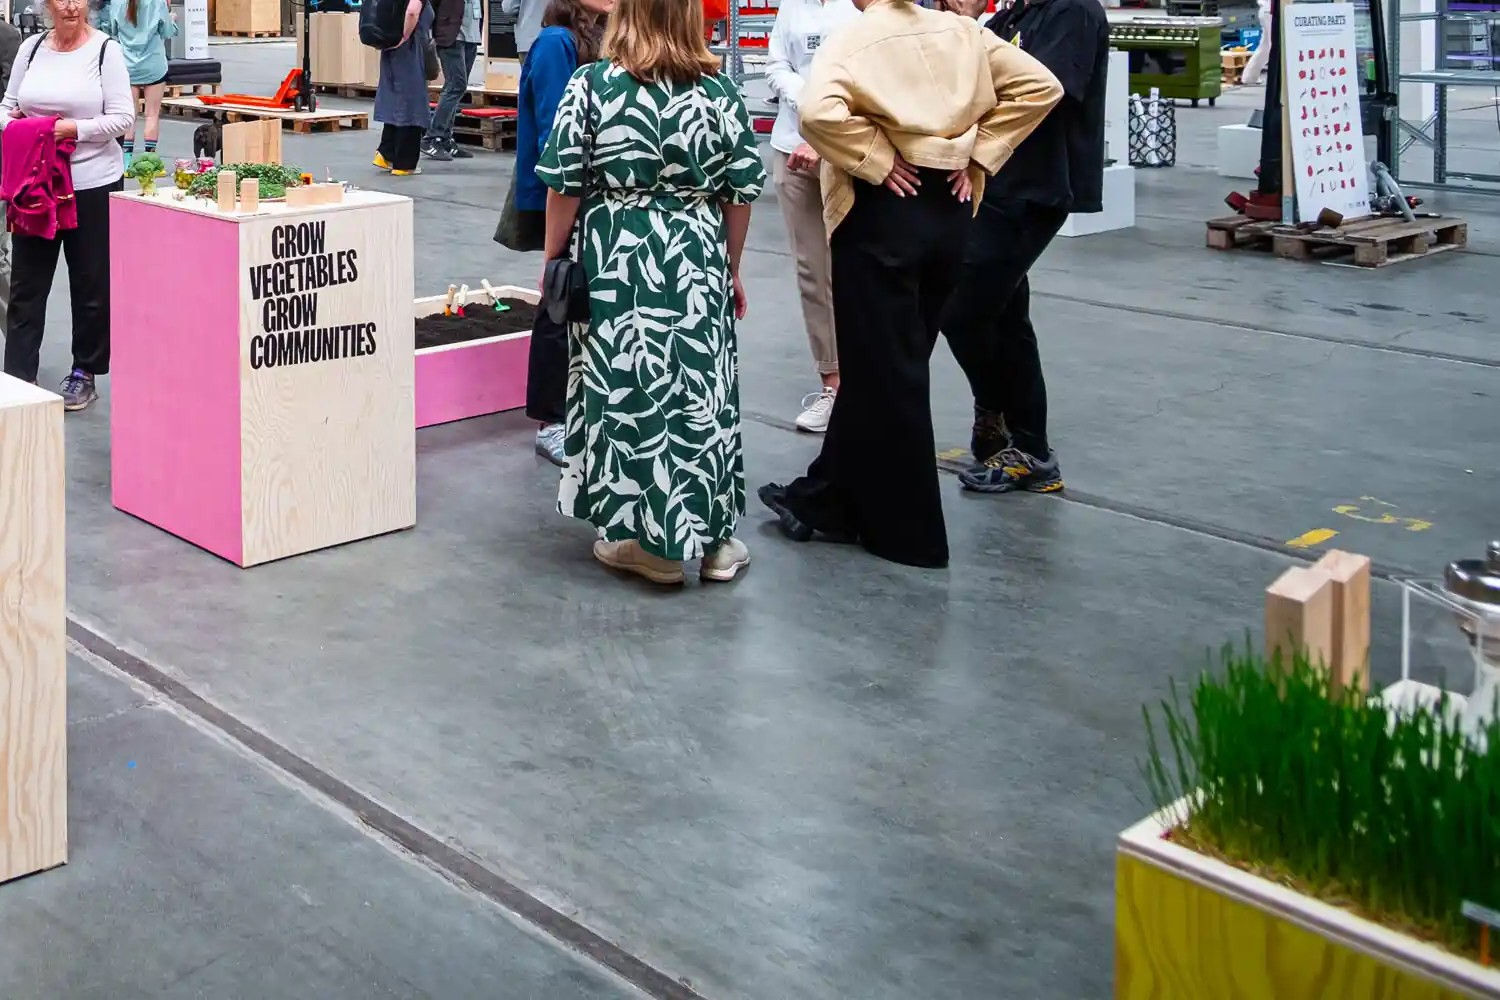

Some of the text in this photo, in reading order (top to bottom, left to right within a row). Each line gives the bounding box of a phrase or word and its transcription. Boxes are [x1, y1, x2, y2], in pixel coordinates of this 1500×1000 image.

[1295, 15, 1346, 27] CURATING PARTS
[272, 221, 326, 259] GROW
[250, 249, 357, 300] VEGETABLES
[263, 293, 318, 333] GROW
[250, 322, 376, 369] COMMUNITIES
